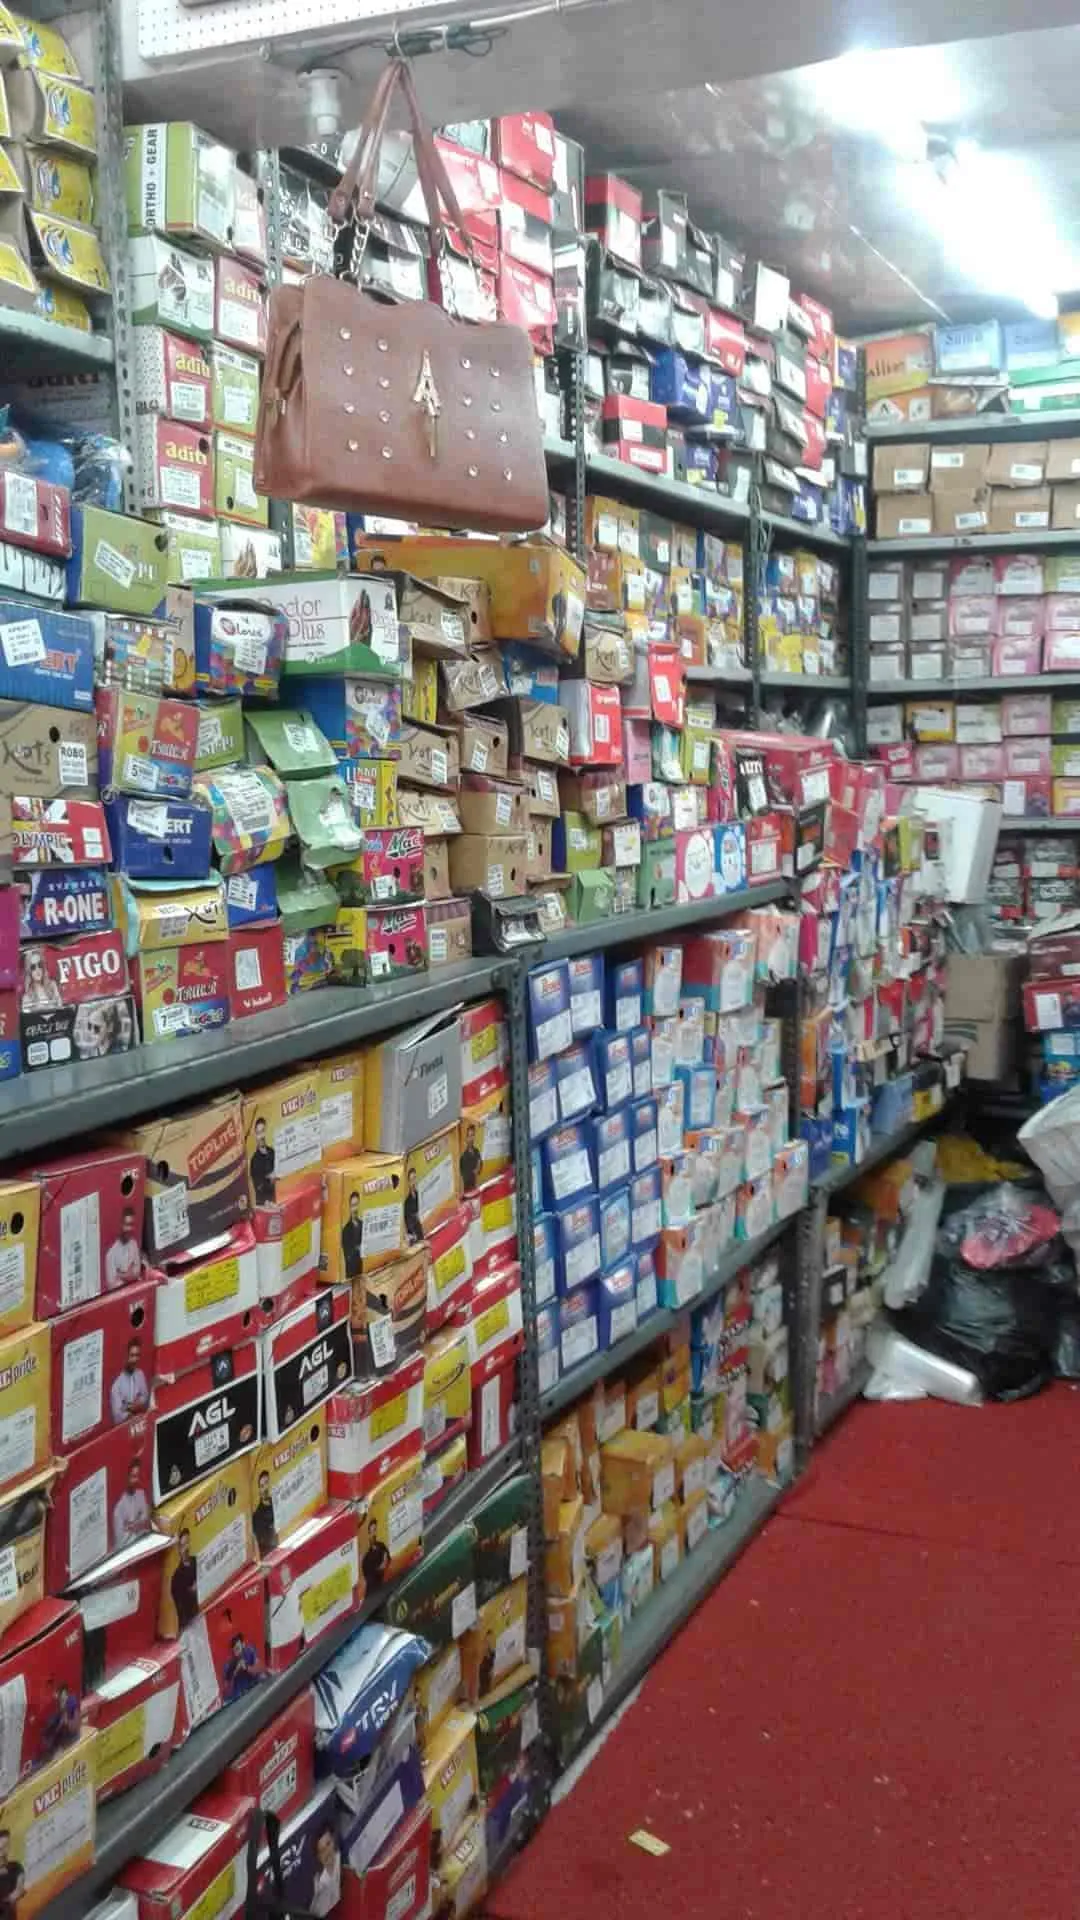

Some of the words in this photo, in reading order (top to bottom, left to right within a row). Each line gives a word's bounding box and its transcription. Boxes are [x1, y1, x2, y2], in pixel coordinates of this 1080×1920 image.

[165, 818, 194, 835] ERT
[44, 892, 104, 927] R-ONE
[57, 949, 121, 984] FIGO
[299, 1340, 334, 1380] AGL
[187, 1397, 237, 1438] AGL
